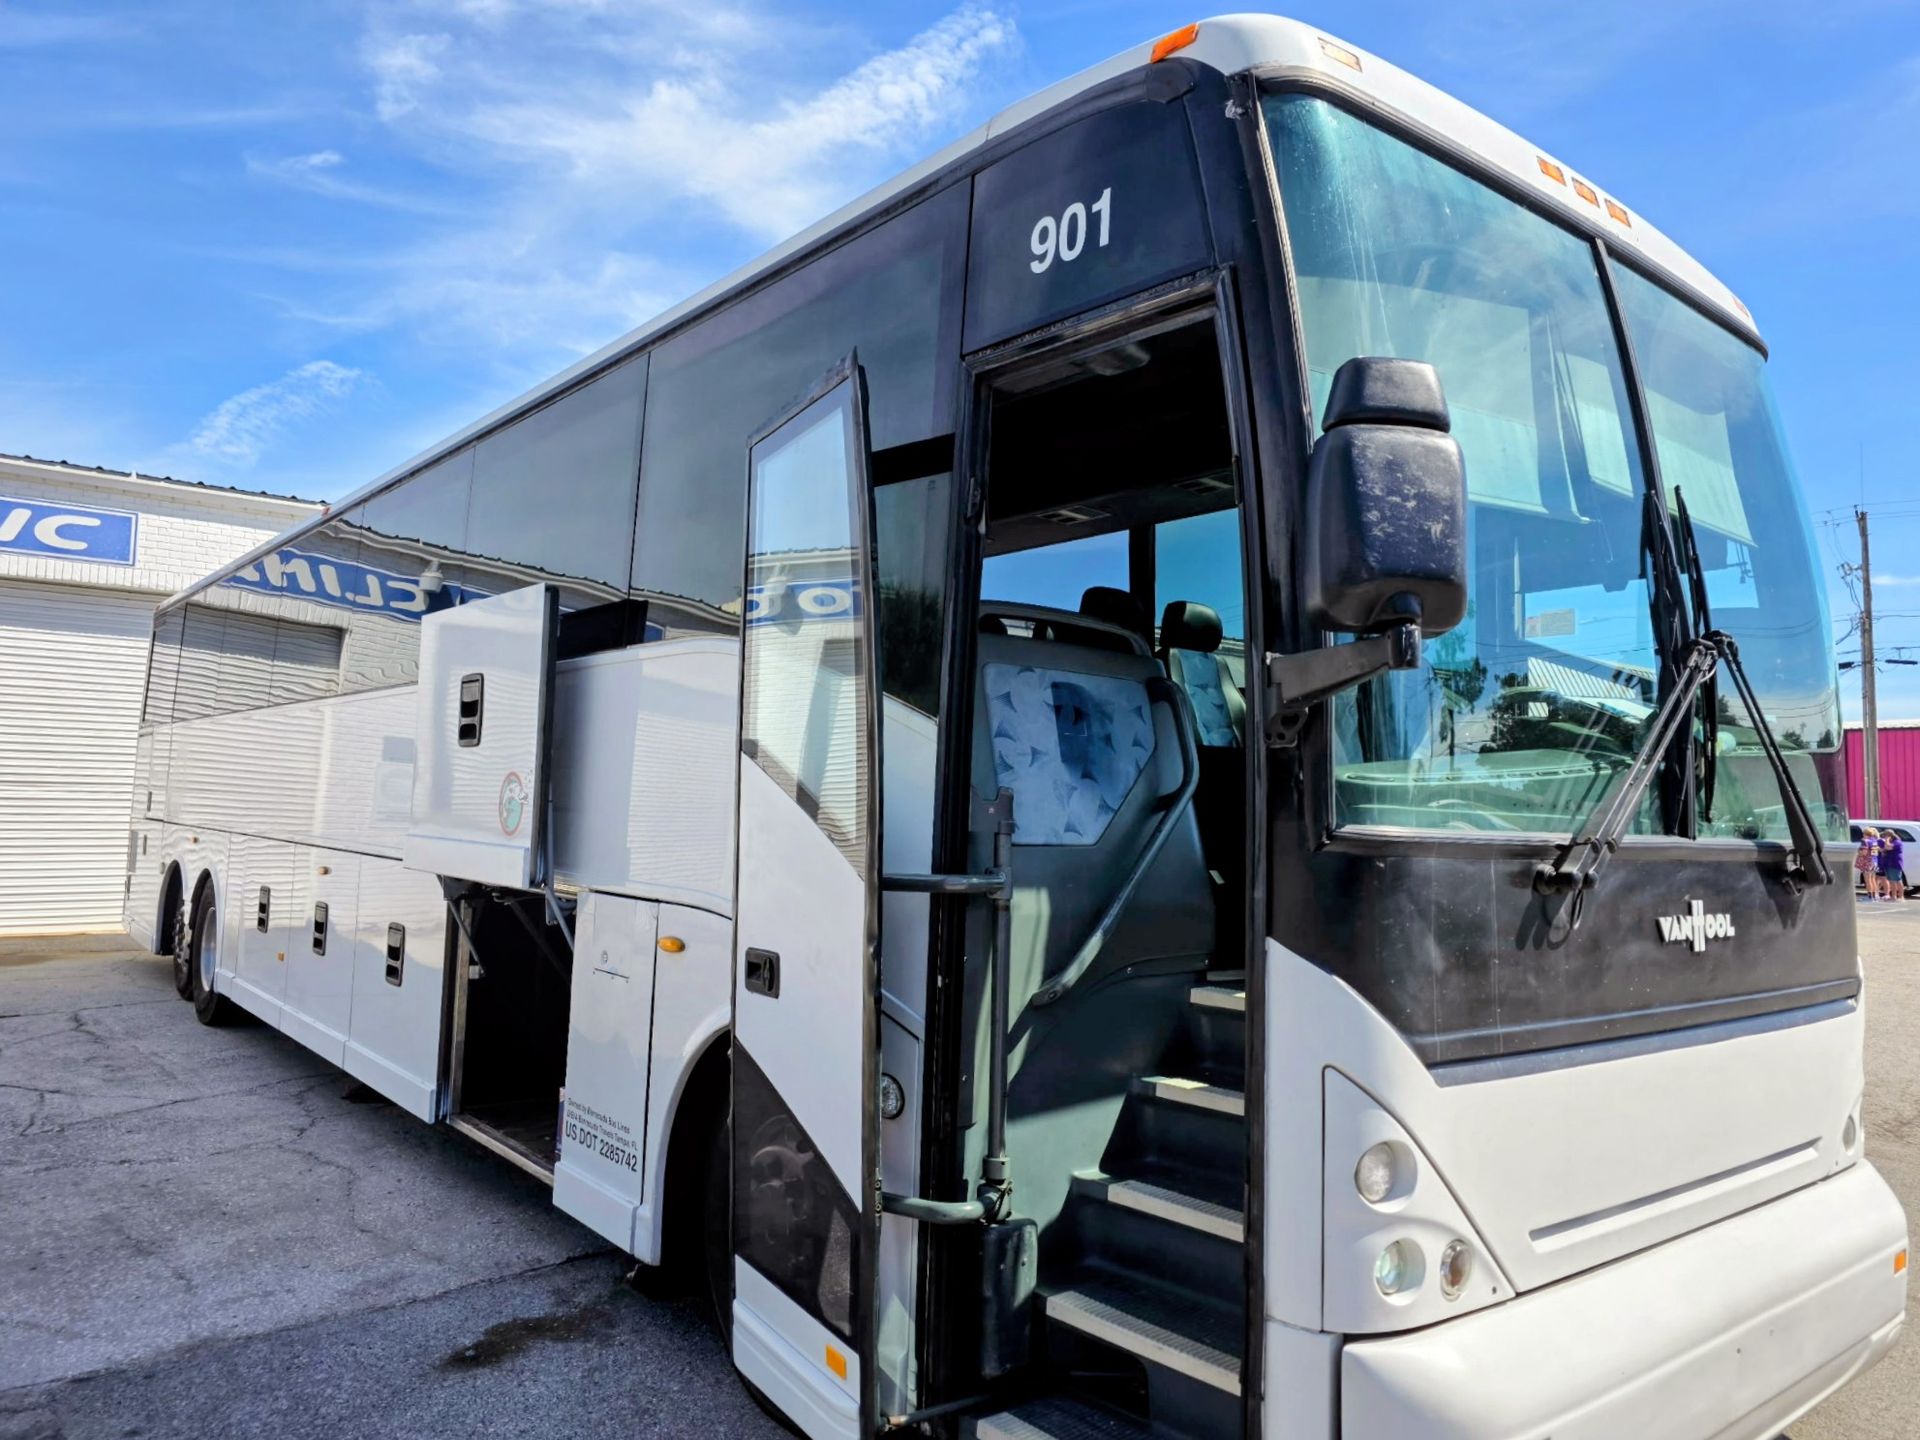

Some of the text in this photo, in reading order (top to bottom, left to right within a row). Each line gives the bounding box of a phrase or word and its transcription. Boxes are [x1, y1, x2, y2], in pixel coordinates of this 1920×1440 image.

[1030, 187, 1112, 274] 901
[565, 1120, 637, 1173] US DOT 2285742
